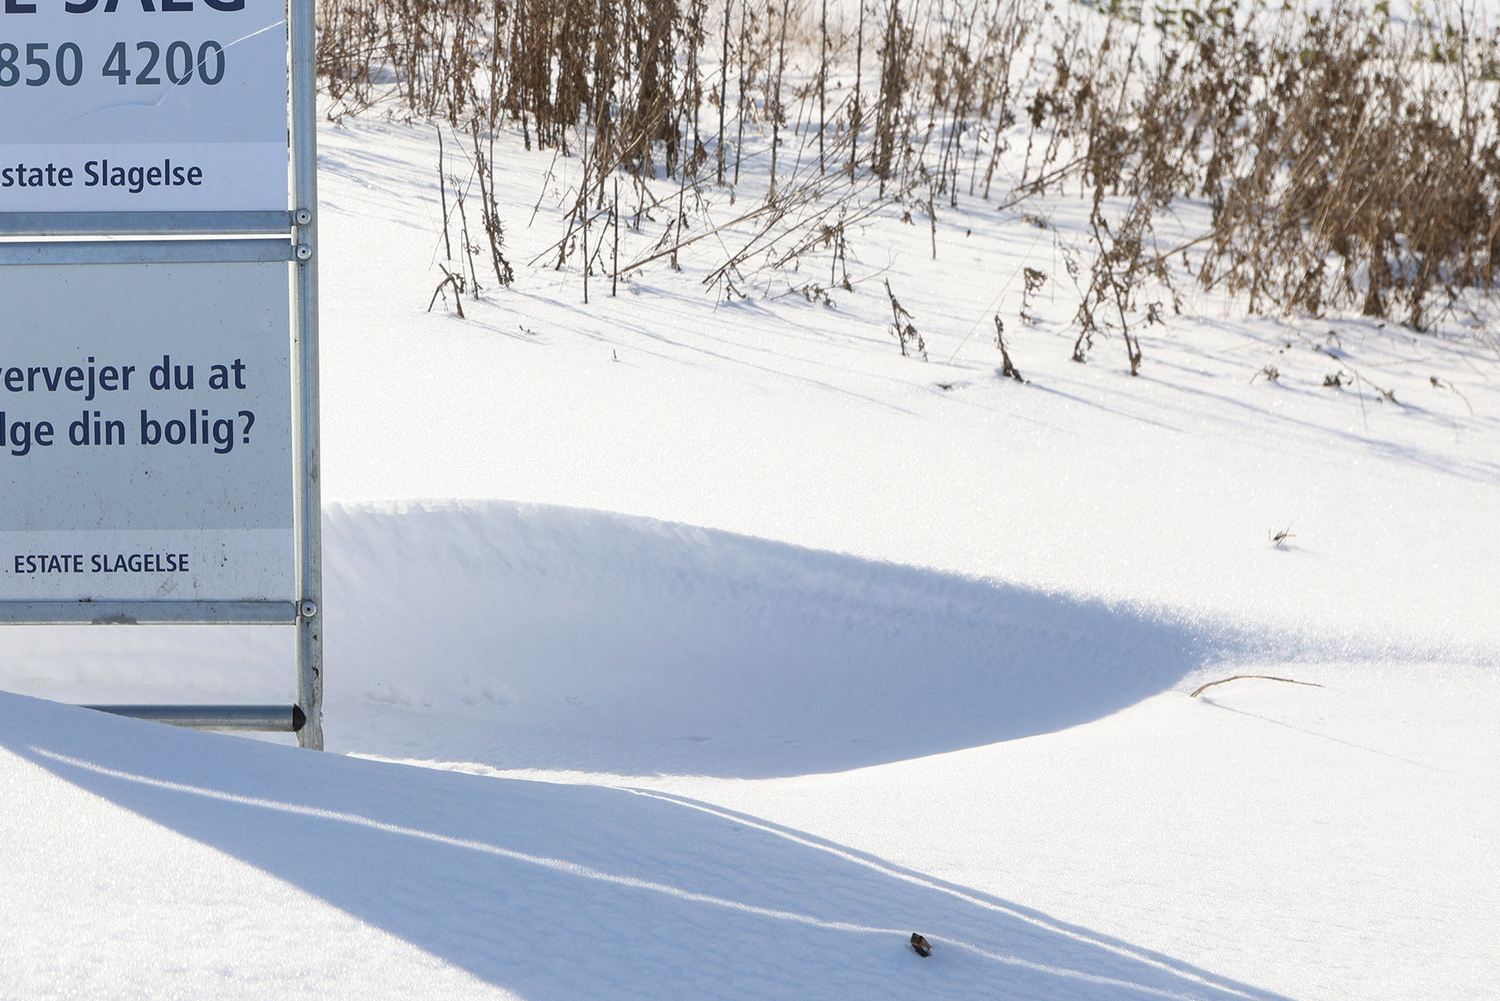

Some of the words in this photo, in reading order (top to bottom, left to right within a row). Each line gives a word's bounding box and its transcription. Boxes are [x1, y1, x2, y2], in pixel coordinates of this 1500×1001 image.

[101, 40, 226, 85] 4200
[84, 159, 203, 193] Slagelse
[149, 355, 194, 391] du
[208, 358, 246, 390] at
[68, 410, 126, 446] din
[140, 409, 256, 454] bolig?
[14, 554, 84, 574] ESTATE
[91, 553, 190, 573] SLAGELSE
